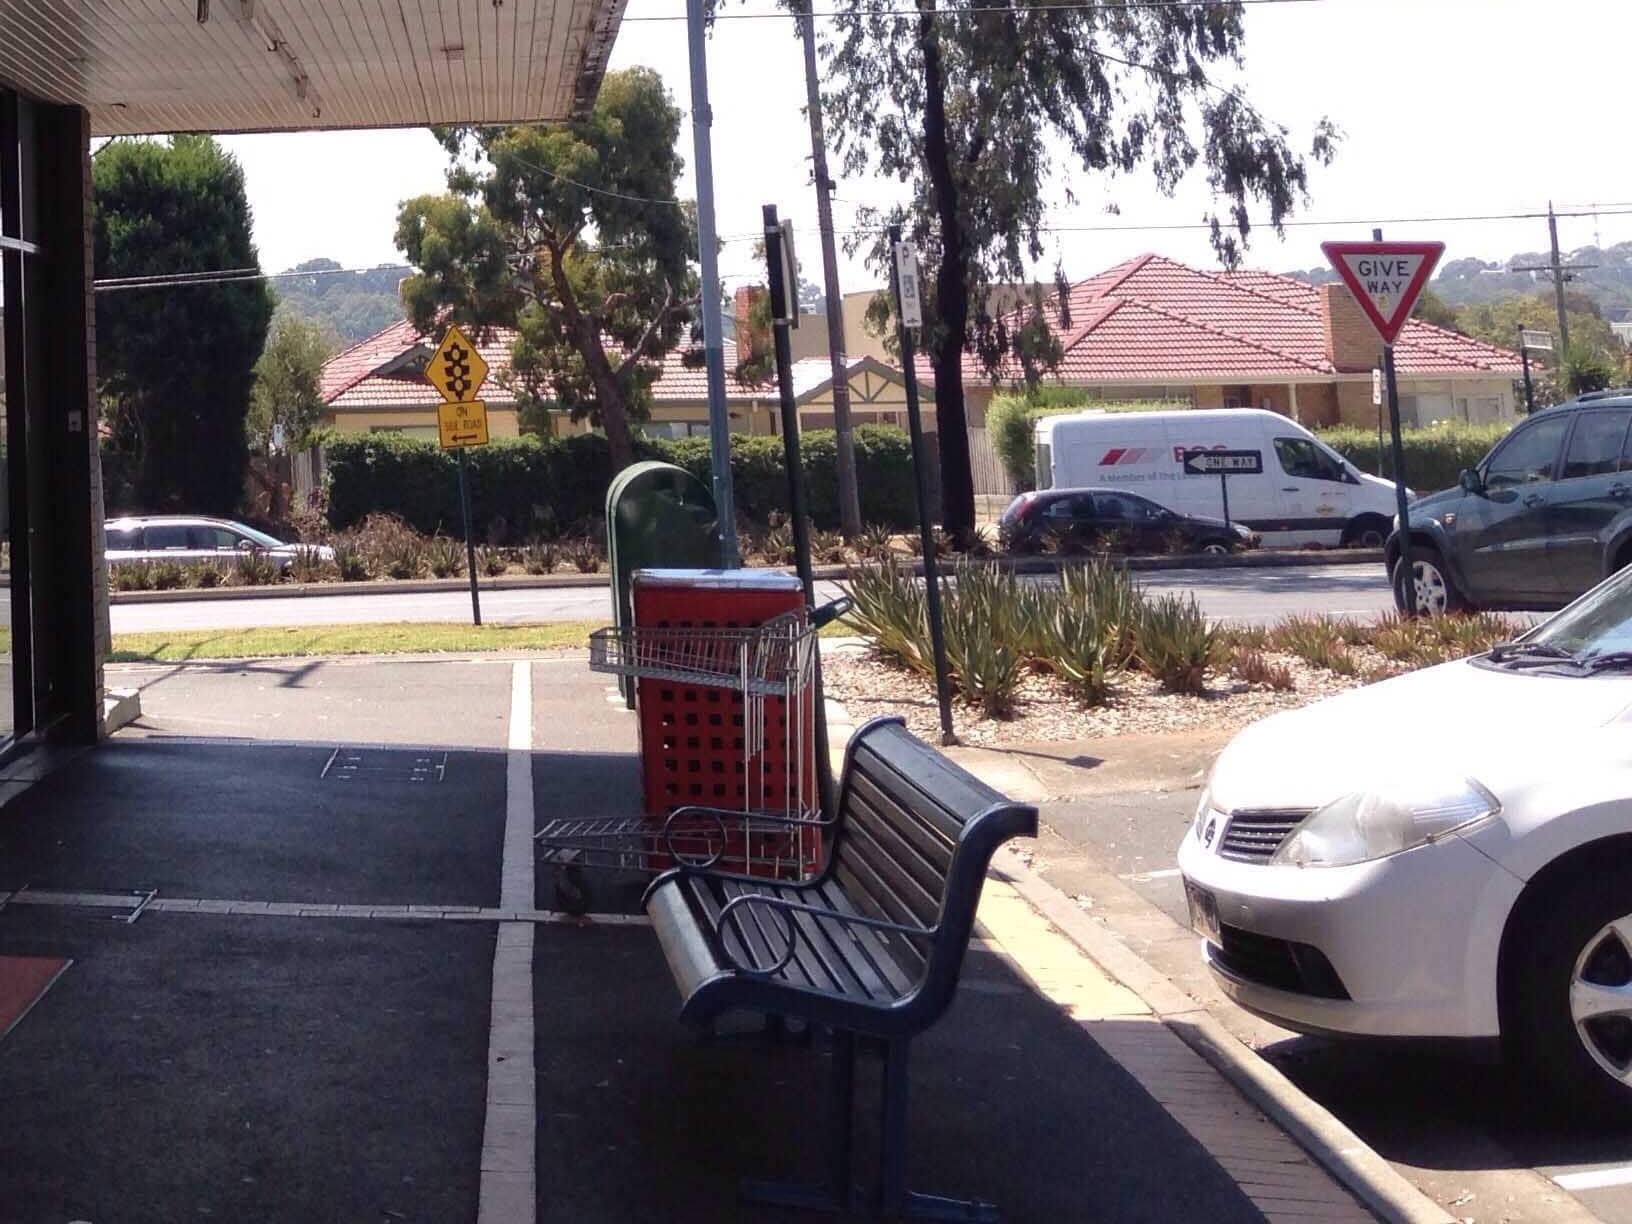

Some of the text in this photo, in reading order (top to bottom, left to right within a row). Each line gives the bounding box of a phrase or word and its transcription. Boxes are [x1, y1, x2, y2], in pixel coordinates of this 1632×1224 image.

[1358, 260, 1410, 277] GIVE
[1367, 280, 1402, 294] WAY
[1231, 456, 1255, 468] WAY
